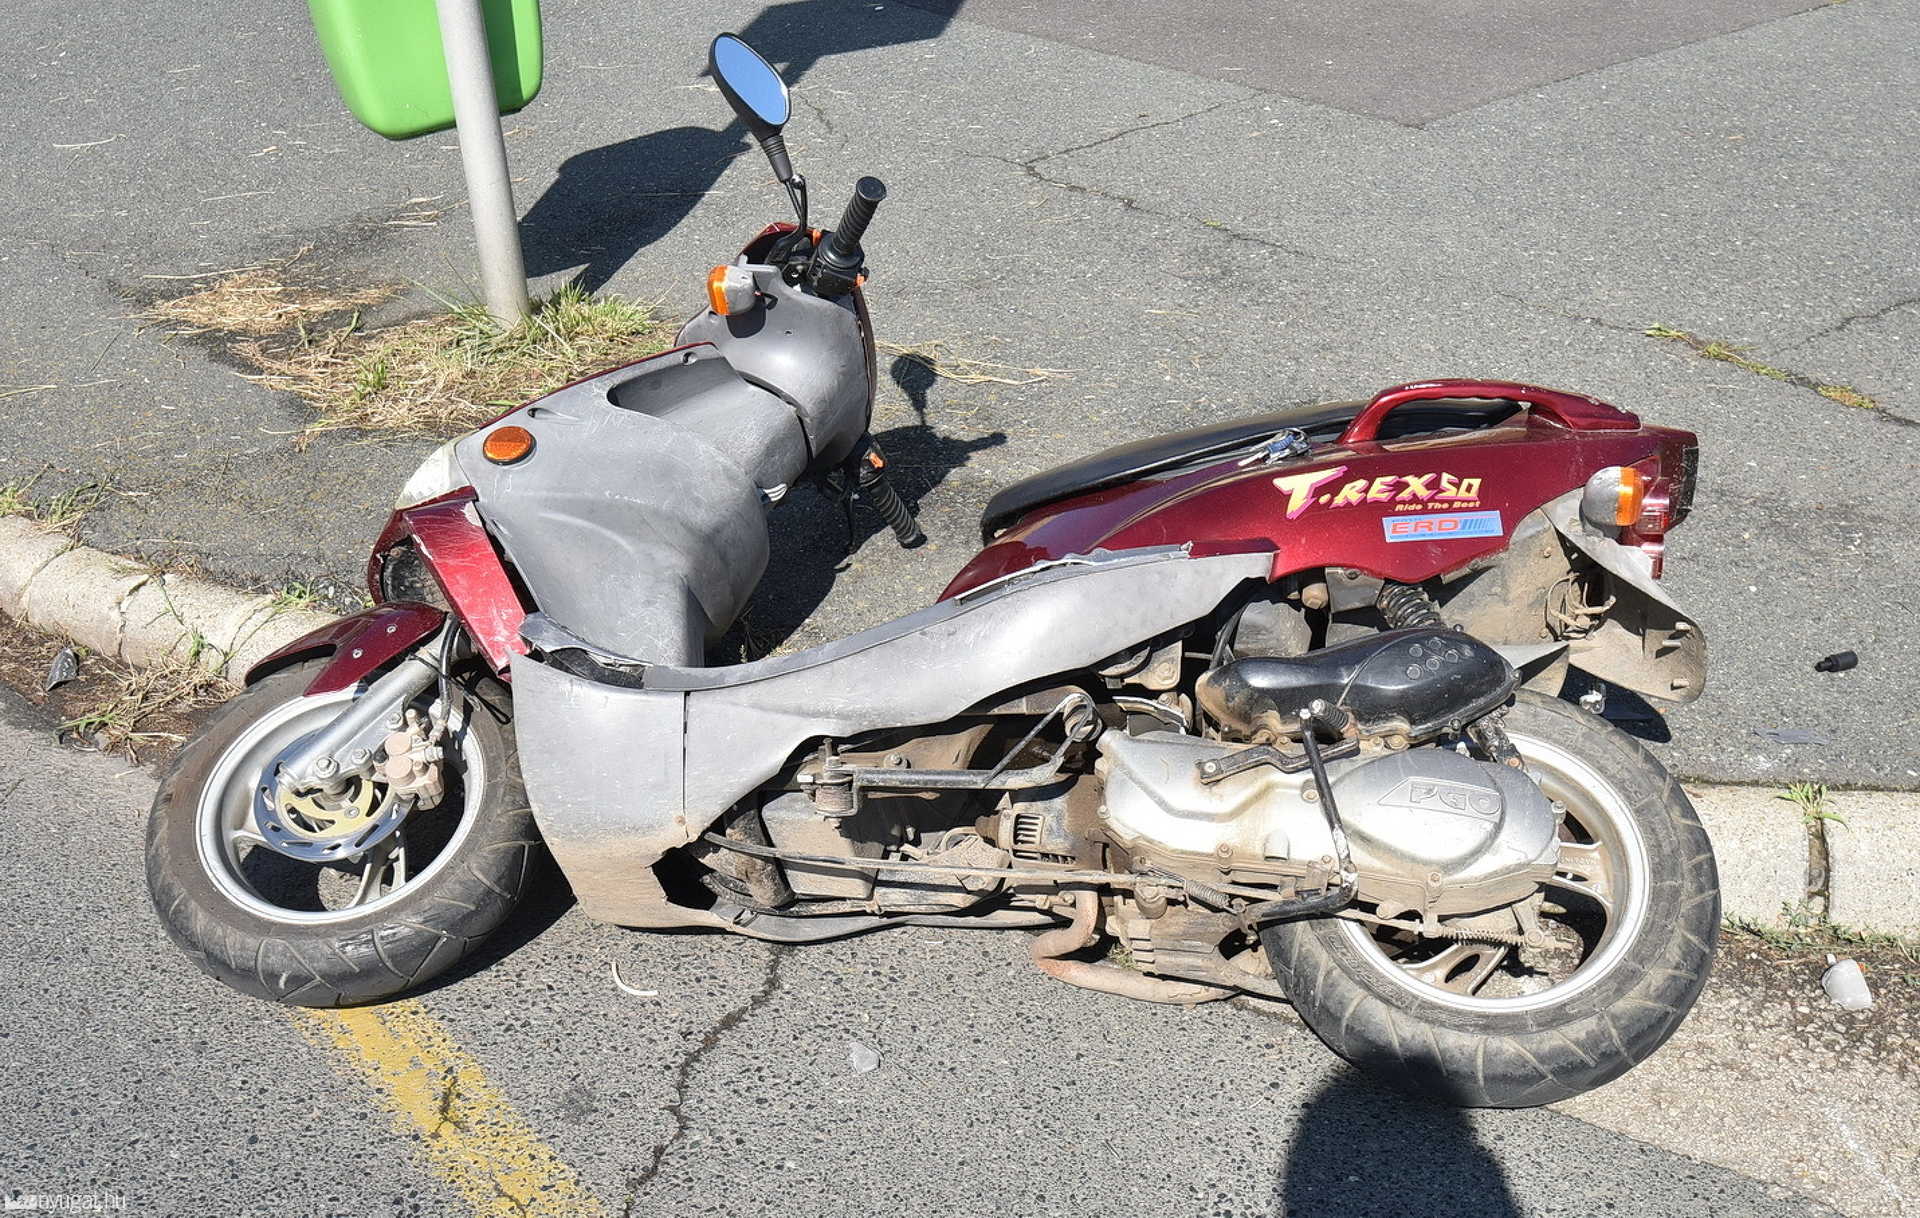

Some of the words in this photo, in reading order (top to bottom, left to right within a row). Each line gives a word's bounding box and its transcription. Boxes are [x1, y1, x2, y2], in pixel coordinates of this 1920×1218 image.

[1395, 503, 1423, 511] Ride
[1391, 519, 1459, 535] ERD
[1409, 783, 1502, 815] PGO
